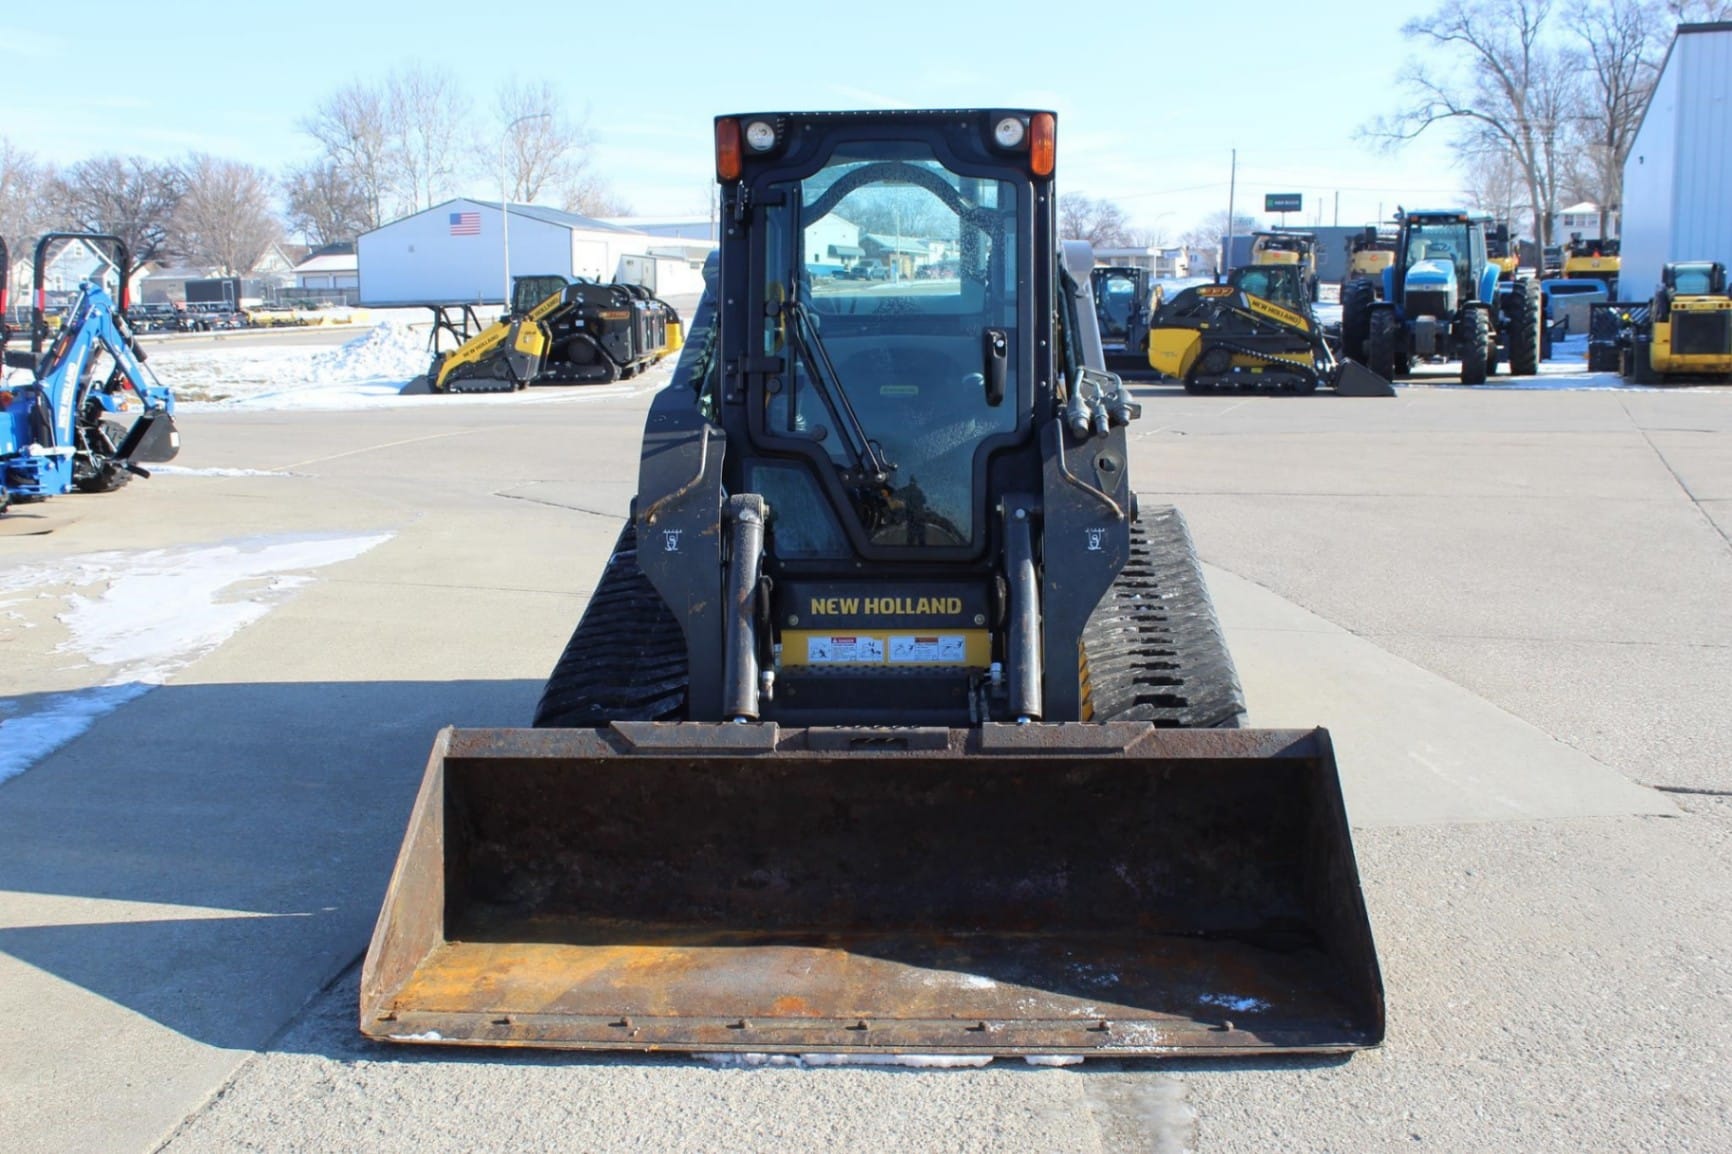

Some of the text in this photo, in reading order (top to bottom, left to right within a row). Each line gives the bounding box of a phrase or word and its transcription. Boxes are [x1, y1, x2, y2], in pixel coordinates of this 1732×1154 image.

[1268, 306, 1299, 325] HOLLAND
[811, 597, 962, 615] NEW HOLLAND
